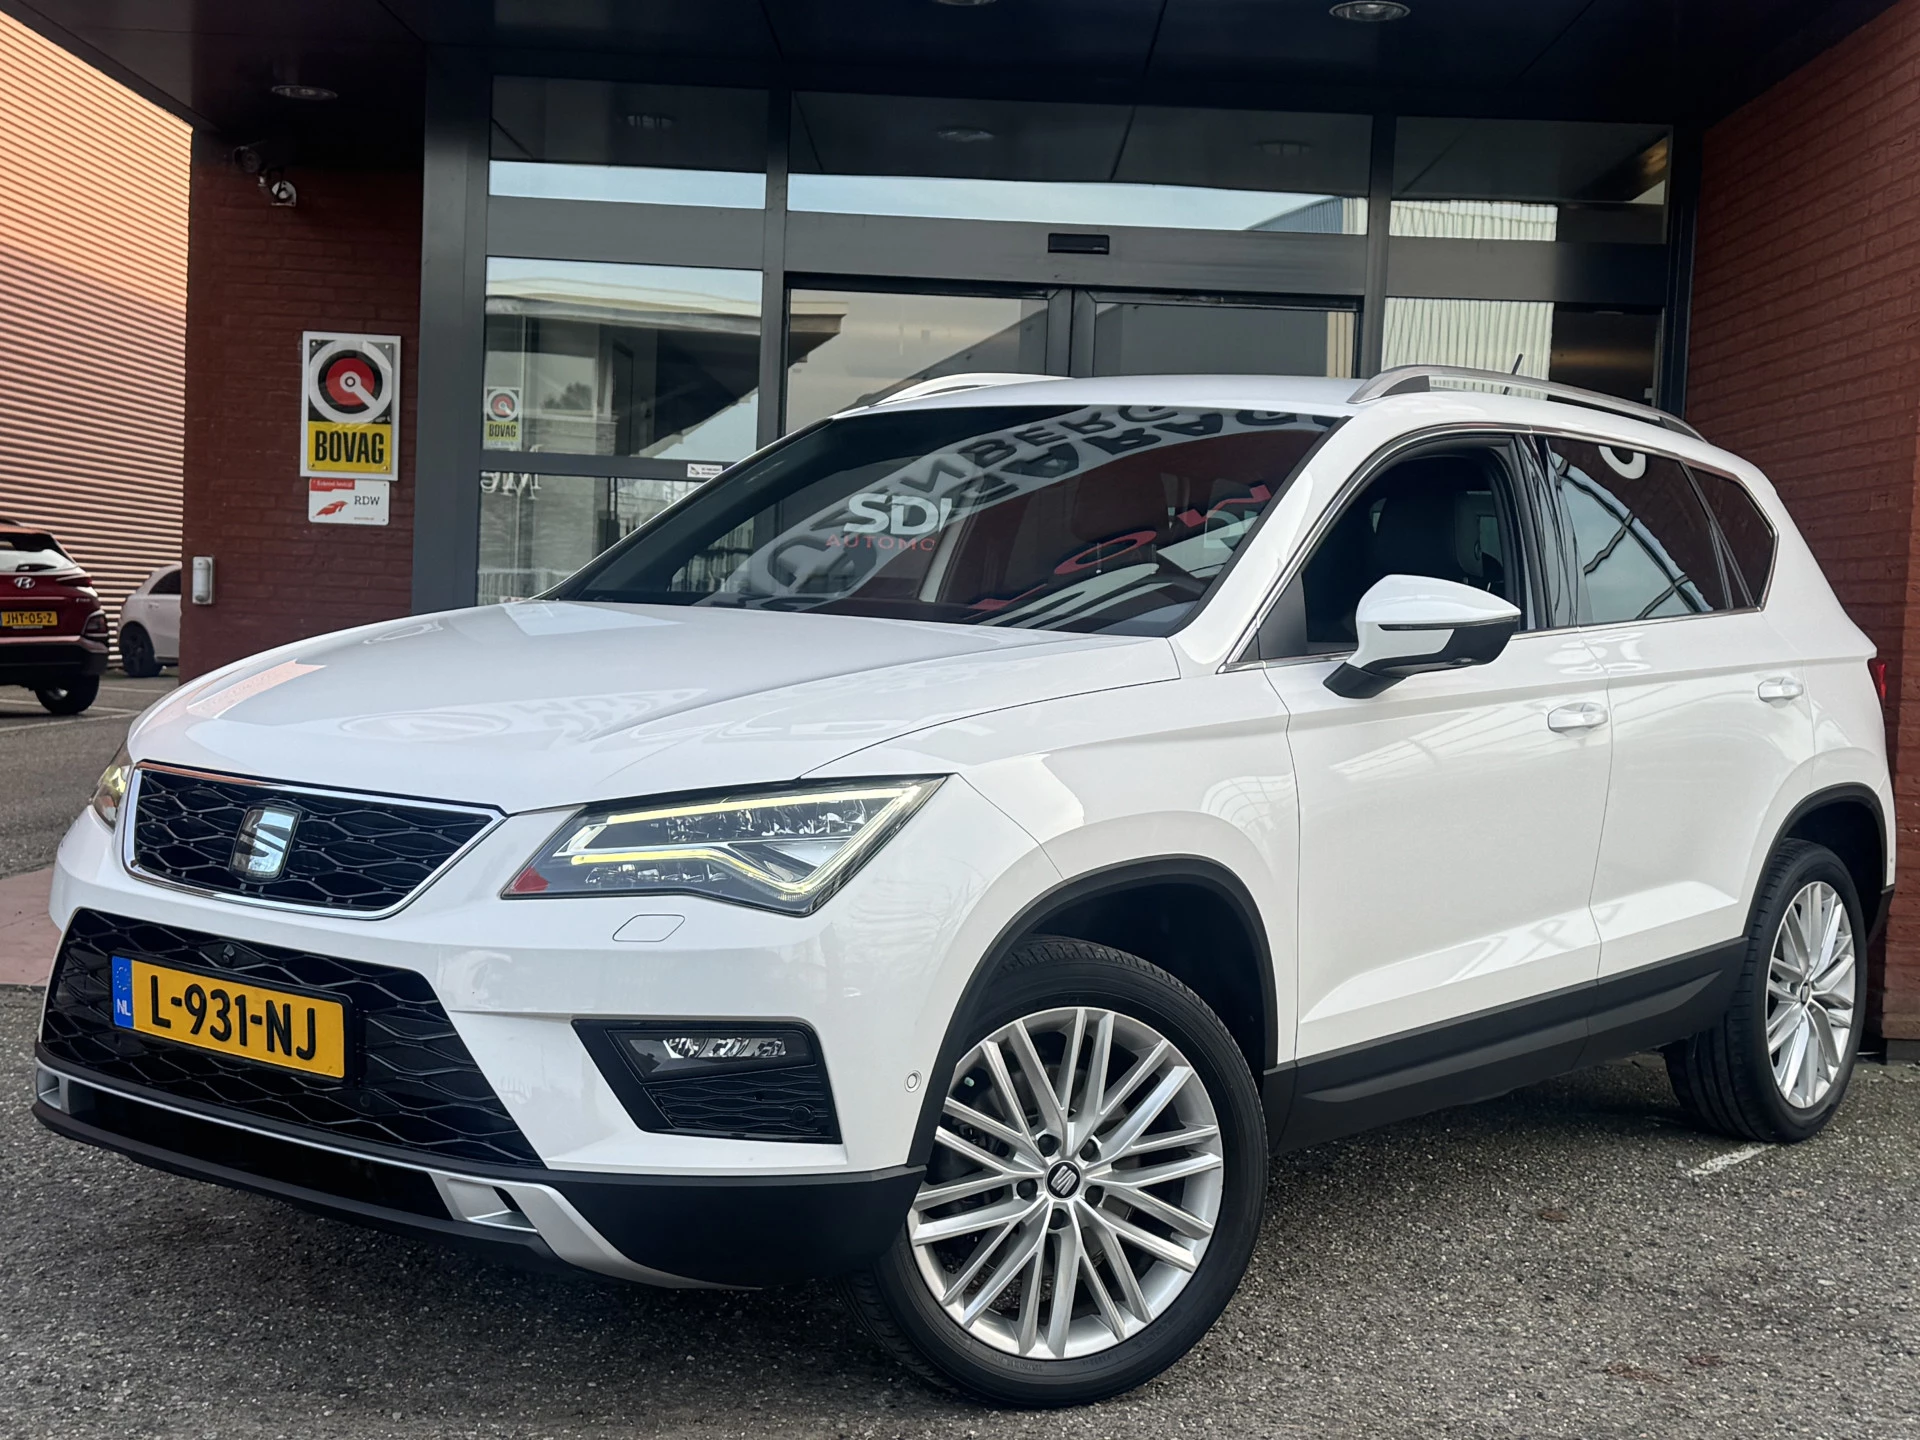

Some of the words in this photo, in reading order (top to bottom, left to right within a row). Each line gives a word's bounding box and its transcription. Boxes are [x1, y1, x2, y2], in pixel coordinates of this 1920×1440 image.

[489, 424, 517, 438] BOVAG
[315, 430, 384, 464] BOVAG
[354, 495, 380, 506] RDW
[844, 493, 952, 535] SDI
[6, 612, 53, 624] JHT-05-Z
[116, 998, 131, 1016] NL
[151, 975, 316, 1061] L-931-NJ
